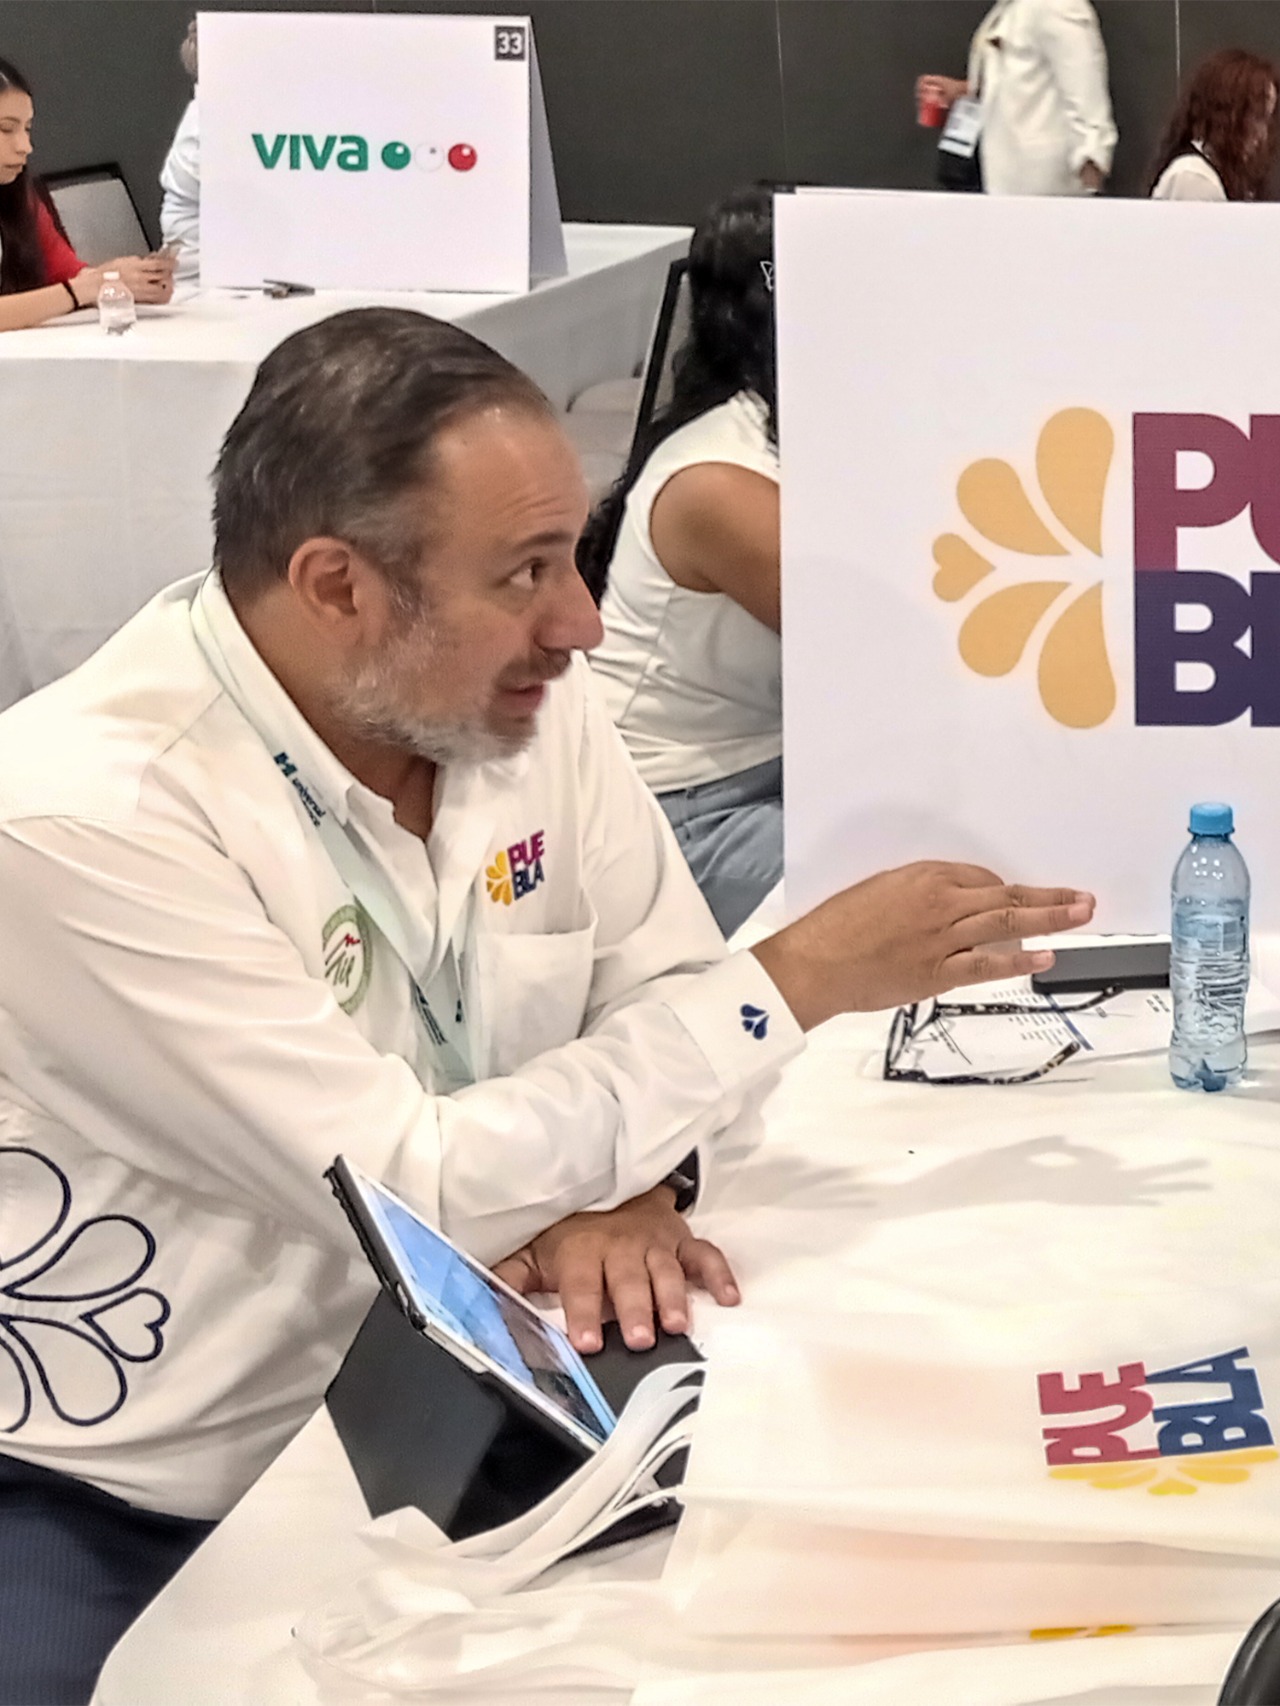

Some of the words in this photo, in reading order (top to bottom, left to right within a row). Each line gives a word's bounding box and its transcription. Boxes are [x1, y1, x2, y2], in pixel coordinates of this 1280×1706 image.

[498, 32, 522, 54] 33
[507, 829, 545, 873] PUE
[512, 859, 545, 901] BLA
[1037, 1362, 1161, 1466] PUE
[1145, 1346, 1274, 1456] BLA
